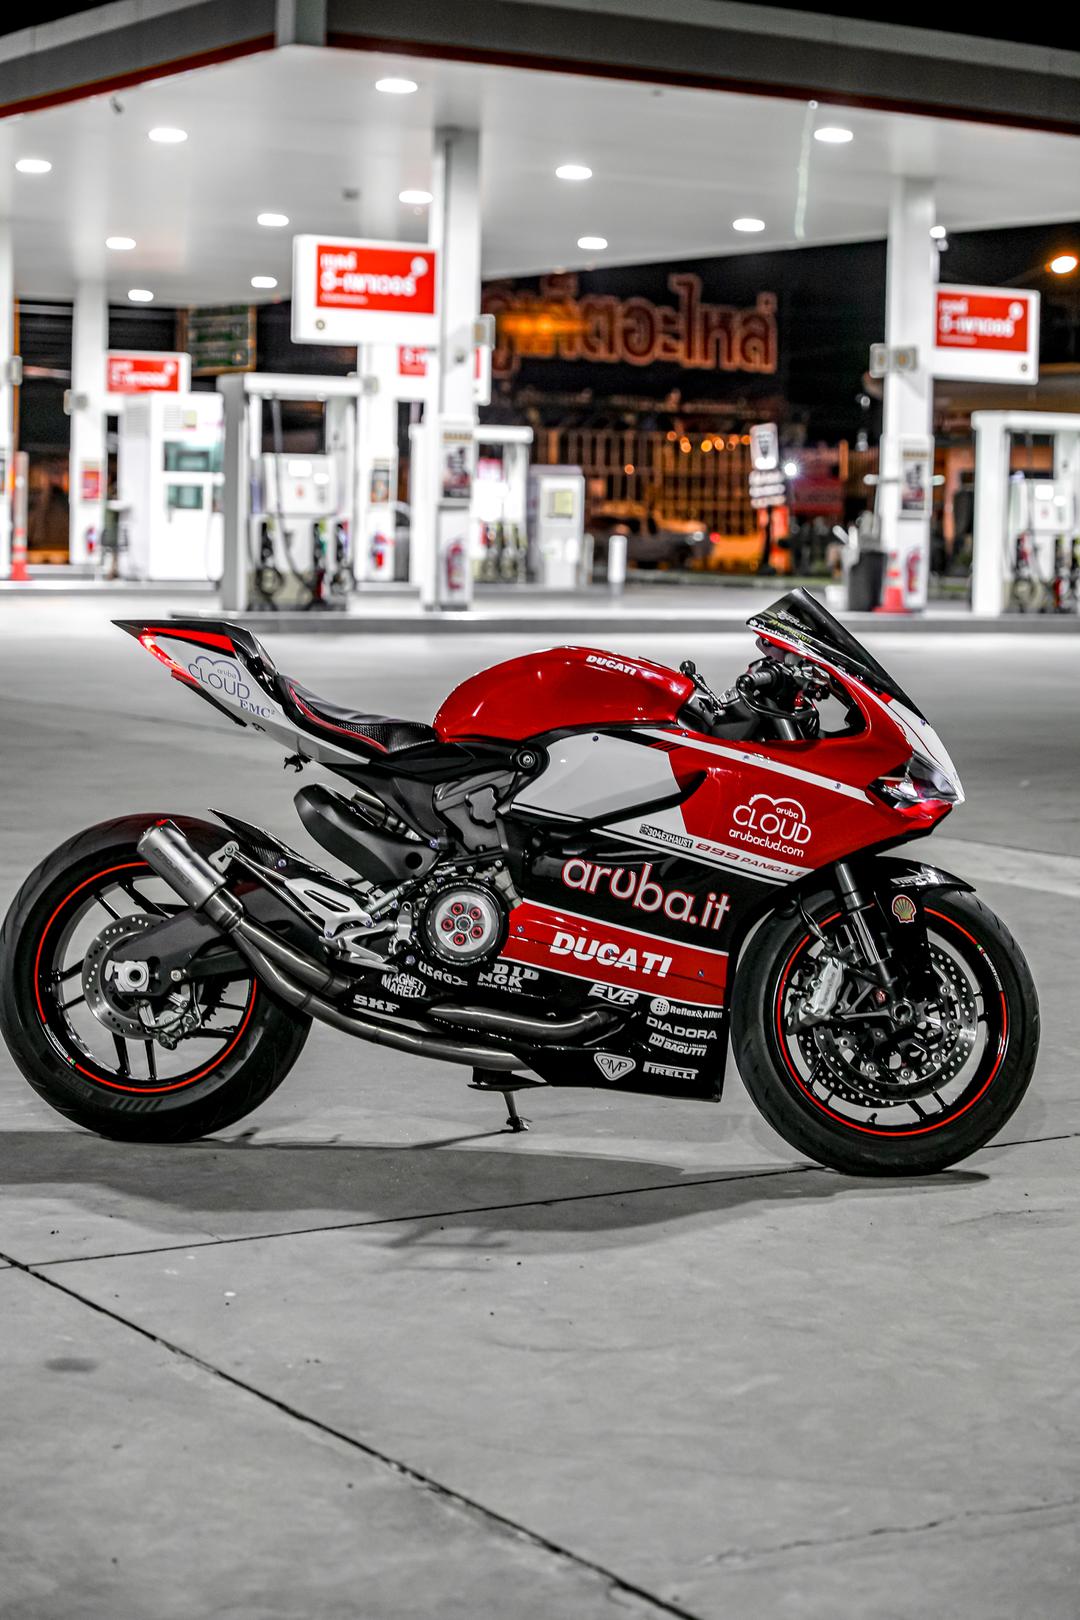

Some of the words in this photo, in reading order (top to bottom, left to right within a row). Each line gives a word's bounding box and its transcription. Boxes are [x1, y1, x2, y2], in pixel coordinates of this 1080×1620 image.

[586, 655, 637, 676] DUCATI
[188, 663, 250, 699] CLOUD
[733, 804, 812, 844] CLOUD
[776, 807, 800, 819] aruba
[729, 828, 804, 858] arubaclud.com
[695, 842, 740, 861] 899
[740, 857, 803, 877] PANIGALE
[562, 857, 731, 930] aruba.it
[548, 931, 673, 978] DUCATI
[478, 972, 523, 988] NGK
[493, 963, 539, 980] DID
[353, 994, 400, 1013] SKF
[588, 983, 639, 1005] EVR
[646, 1016, 718, 1040] DIADORA
[663, 1041, 707, 1057] BAGUTTI
[642, 1061, 699, 1080] PIRELLI
